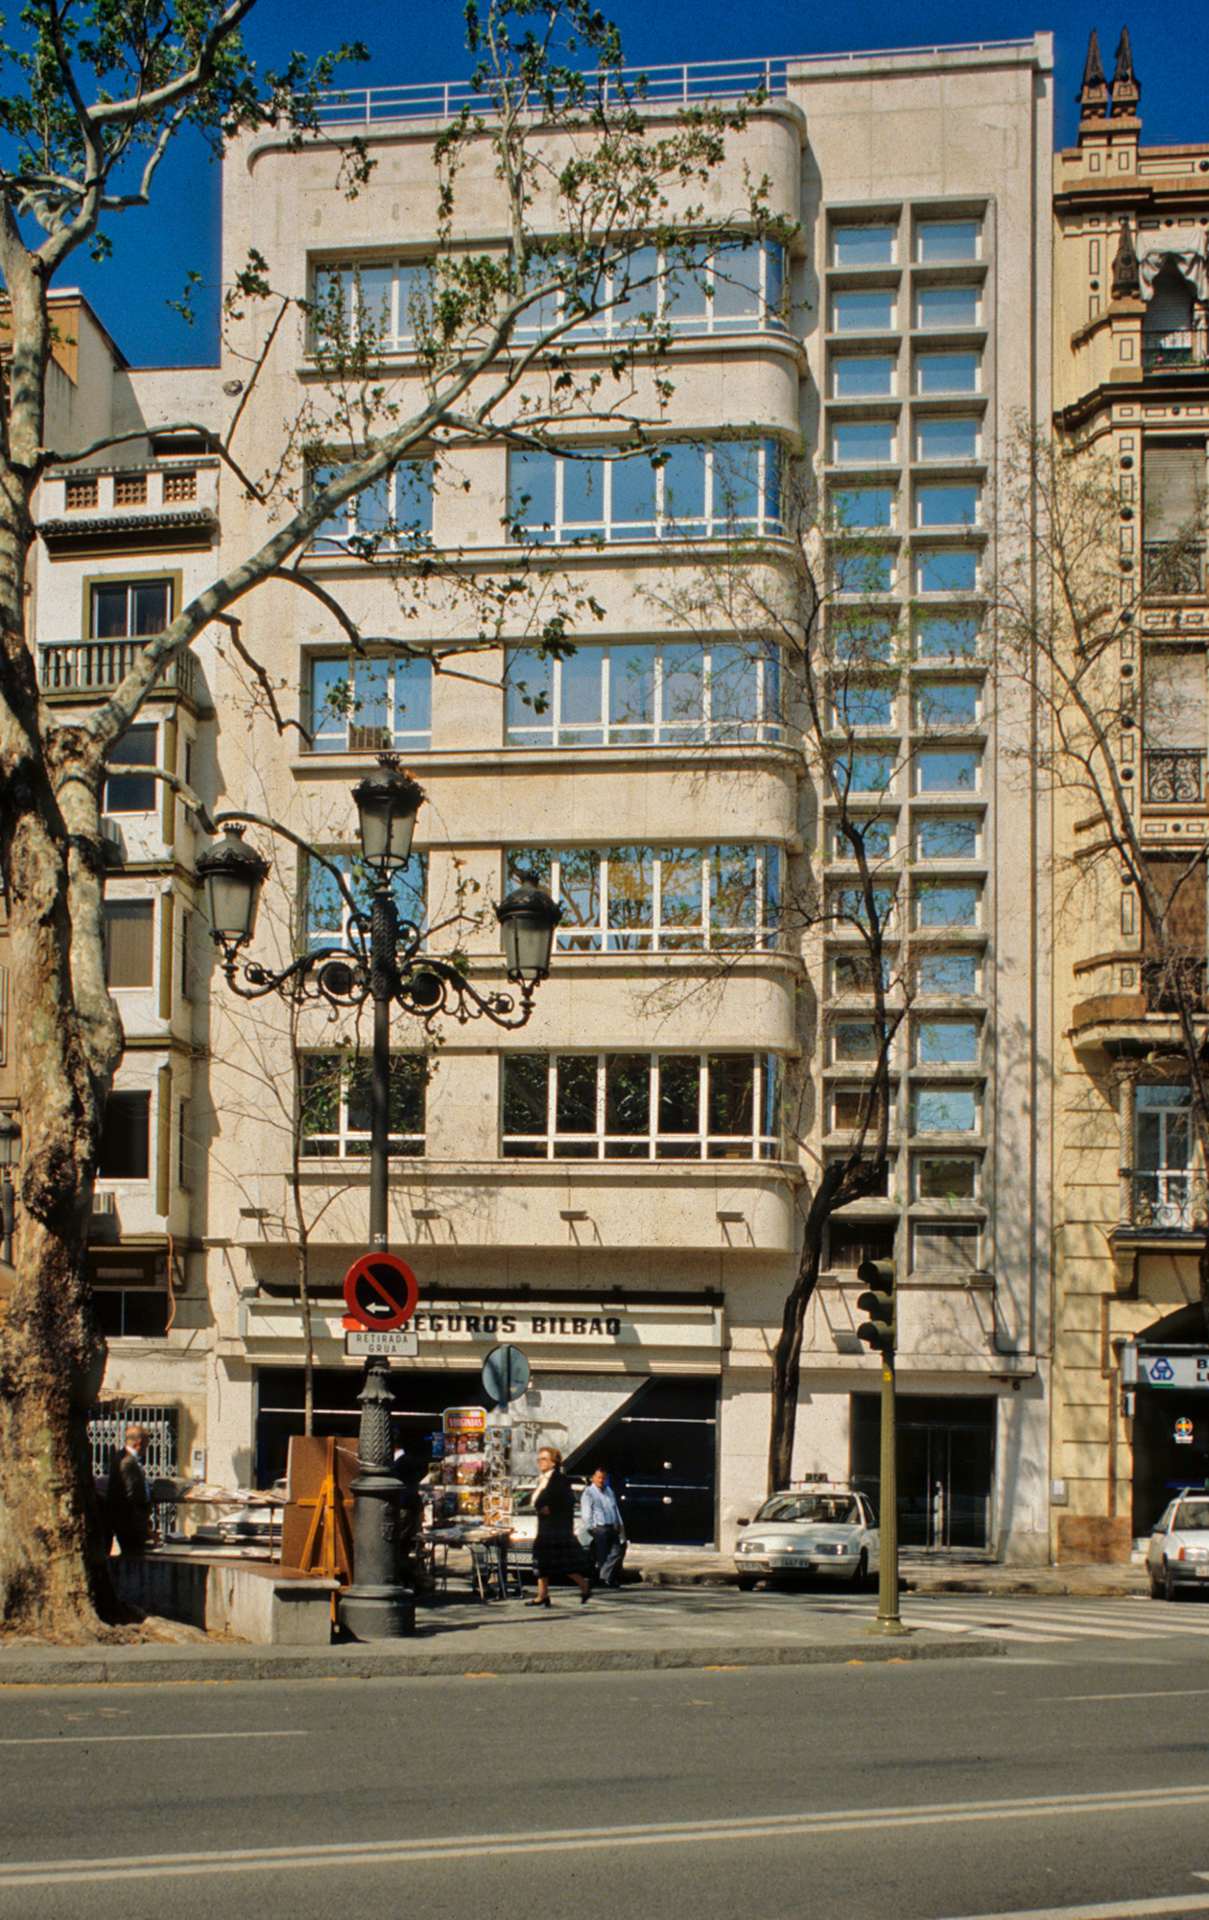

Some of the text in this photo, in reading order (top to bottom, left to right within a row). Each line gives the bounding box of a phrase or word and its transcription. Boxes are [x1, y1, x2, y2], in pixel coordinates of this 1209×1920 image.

[531, 1316, 621, 1336] BILBAO
[356, 1333, 409, 1344] RETIRADA
[368, 1344, 397, 1353] GRUA
[1196, 1359, 1209, 1369] B
[1012, 1380, 1021, 1391] 6
